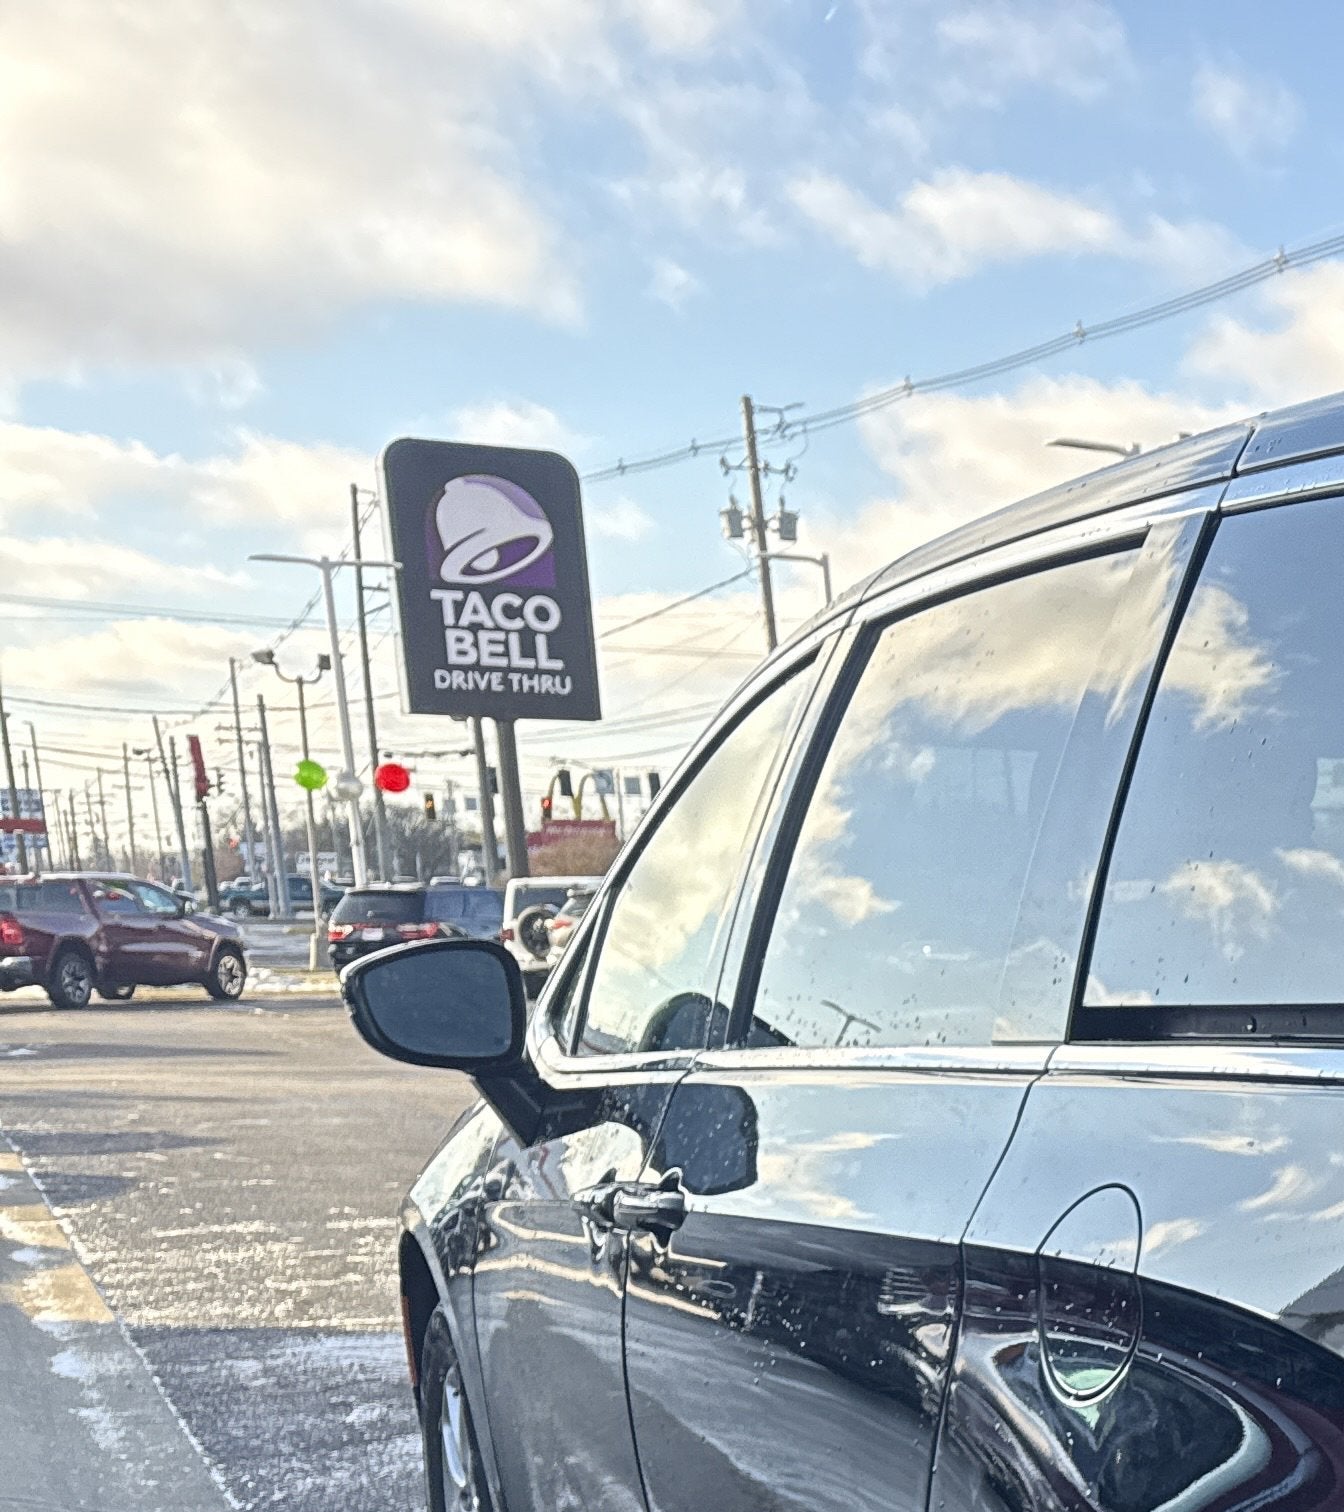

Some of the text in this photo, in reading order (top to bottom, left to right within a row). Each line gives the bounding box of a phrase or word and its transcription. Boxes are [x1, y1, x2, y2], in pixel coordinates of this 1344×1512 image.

[430, 588, 562, 633] TACO
[445, 627, 565, 671] BELL
[433, 668, 573, 695] DRIVE THRU
